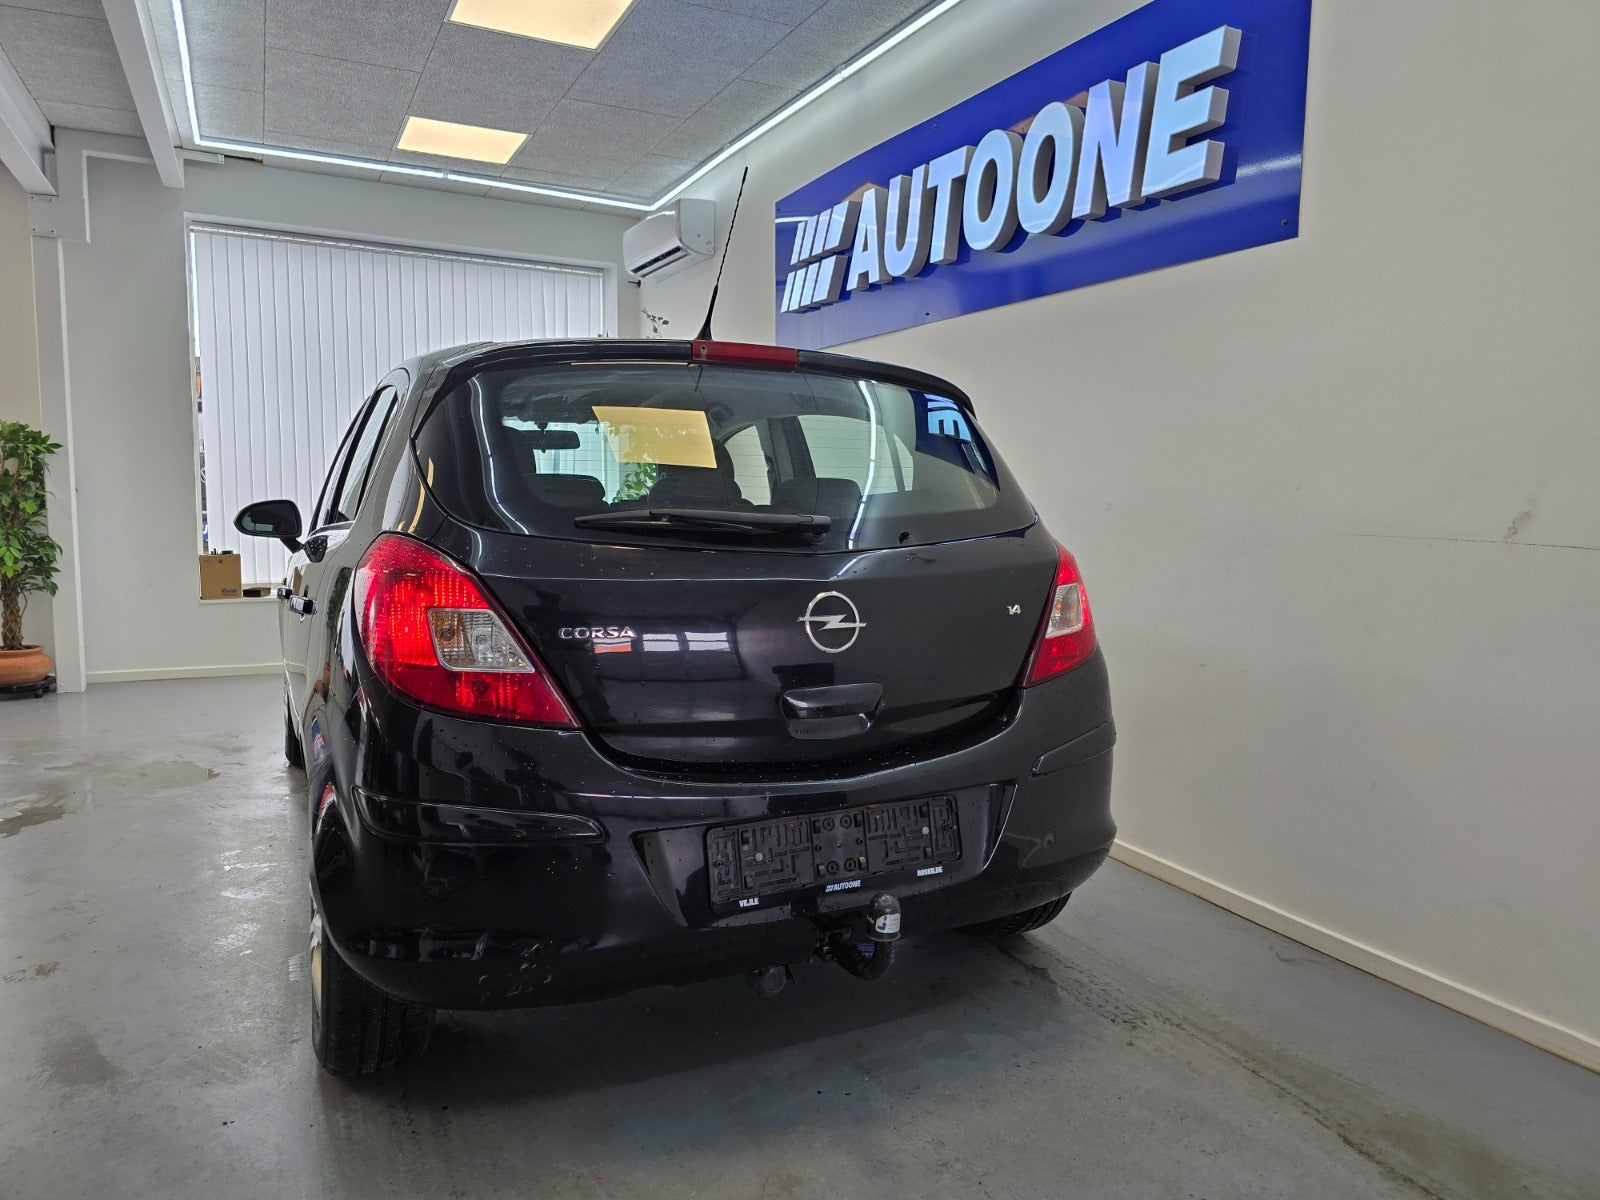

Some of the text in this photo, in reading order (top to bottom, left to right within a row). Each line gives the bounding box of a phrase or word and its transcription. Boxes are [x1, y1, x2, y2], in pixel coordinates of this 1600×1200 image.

[846, 25, 1242, 291] AUTOONE
[559, 626, 635, 639] CORSA
[833, 880, 861, 891] AUTOONE
